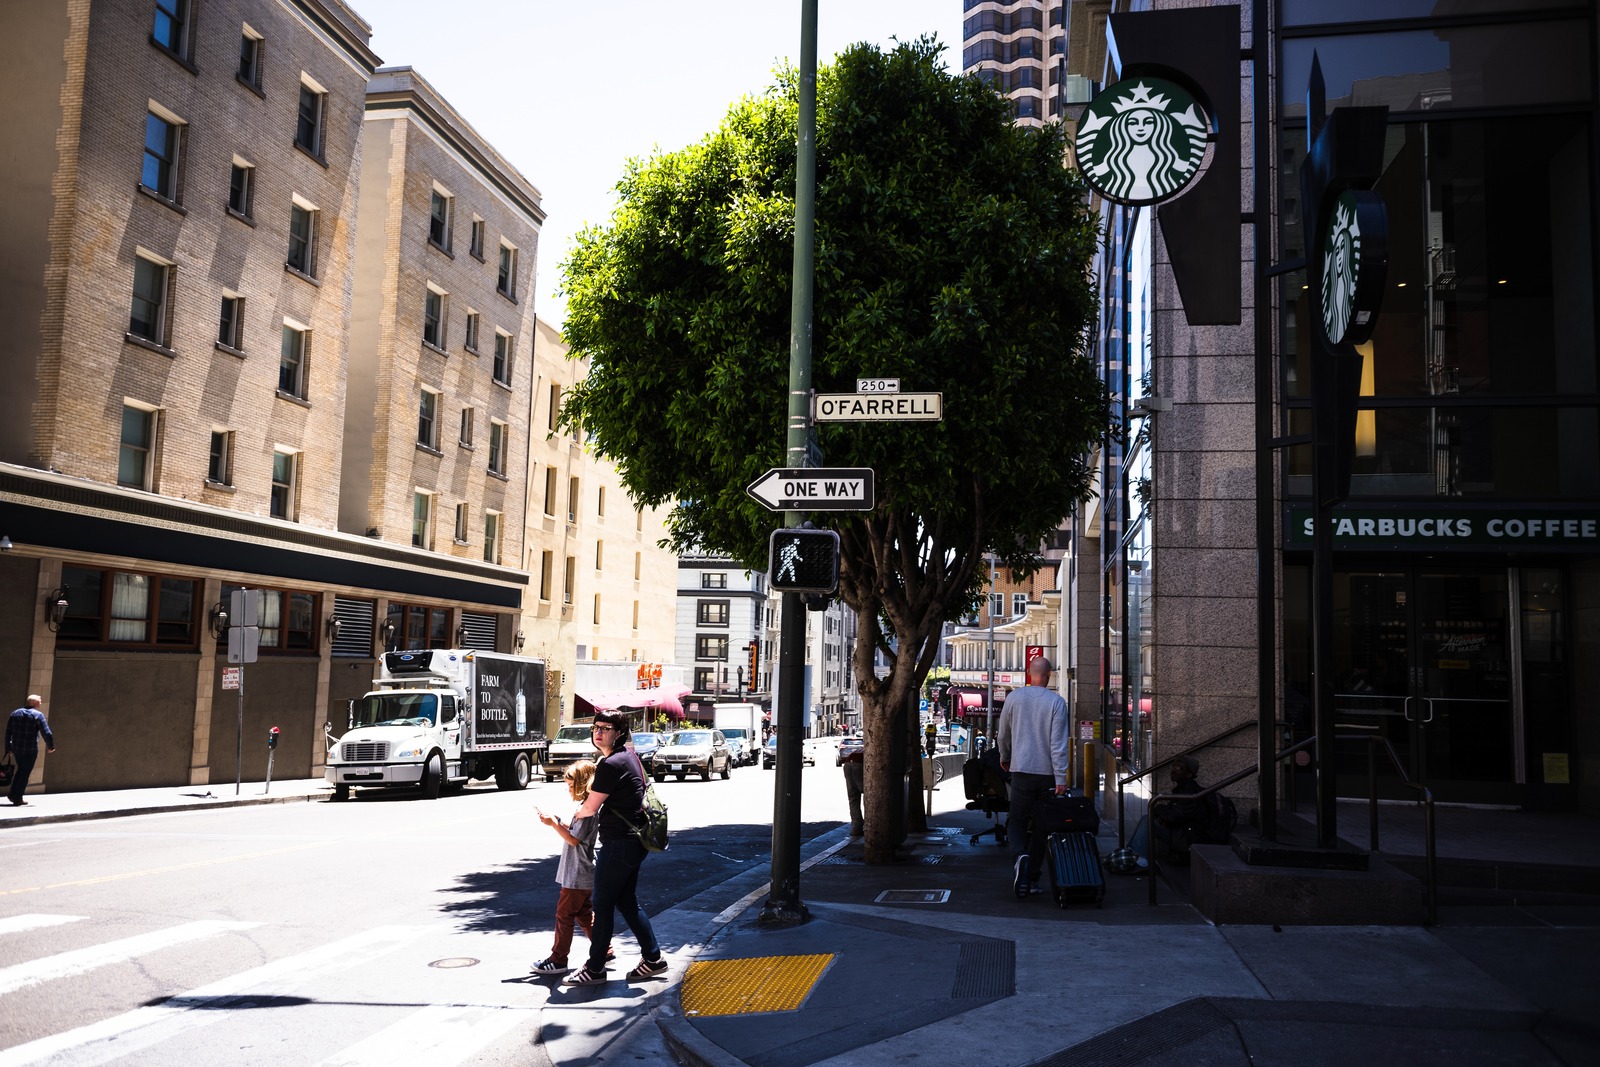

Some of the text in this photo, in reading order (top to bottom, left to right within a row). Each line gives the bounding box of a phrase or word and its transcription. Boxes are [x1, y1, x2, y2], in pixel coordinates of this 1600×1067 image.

[861, 381, 885, 391] 250
[821, 399, 935, 416] O'FARRELL
[784, 482, 859, 497] ONE WAY
[1303, 517, 1597, 538] SARBUCKS COFFEE
[481, 674, 499, 688] FARM
[481, 691, 491, 704] TO
[481, 708, 508, 721] BOTTLE.
